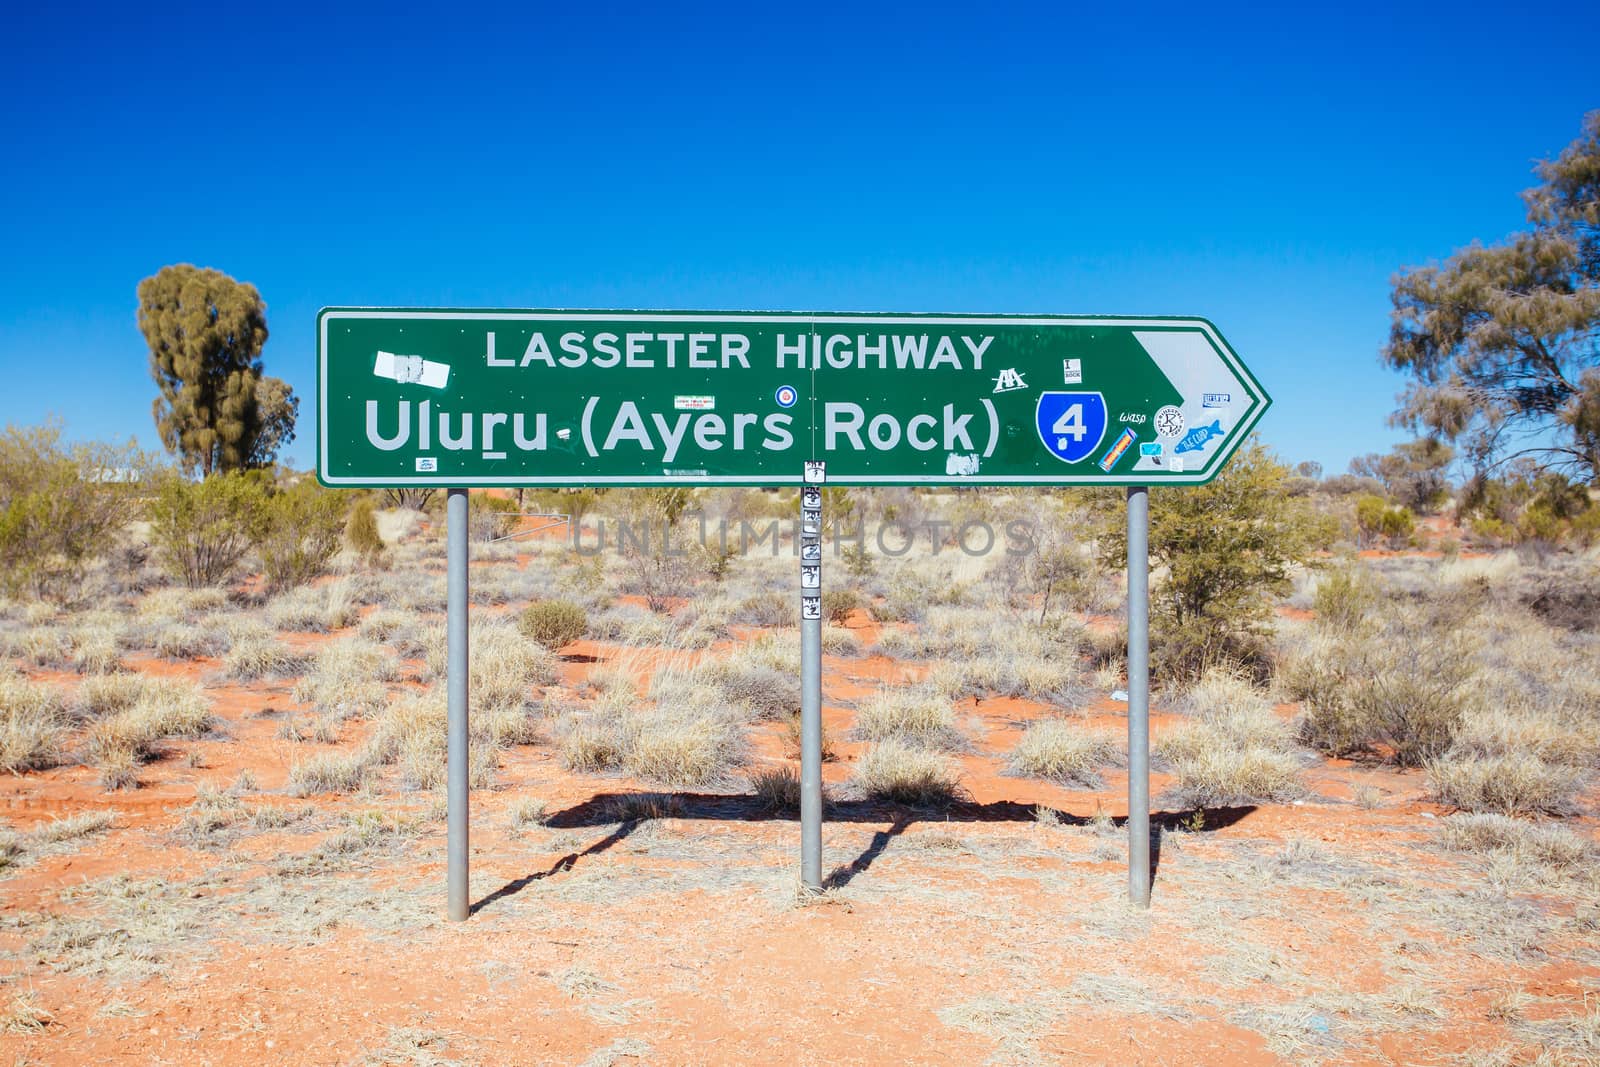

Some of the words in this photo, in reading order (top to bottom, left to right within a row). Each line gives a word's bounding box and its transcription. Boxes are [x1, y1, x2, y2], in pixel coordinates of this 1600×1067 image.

[487, 332, 751, 368] LASSETER
[776, 333, 994, 370] HIGHWAY
[582, 396, 794, 463] (Ayers
[825, 397, 1000, 457] Rock)
[1052, 403, 1088, 442] 4
